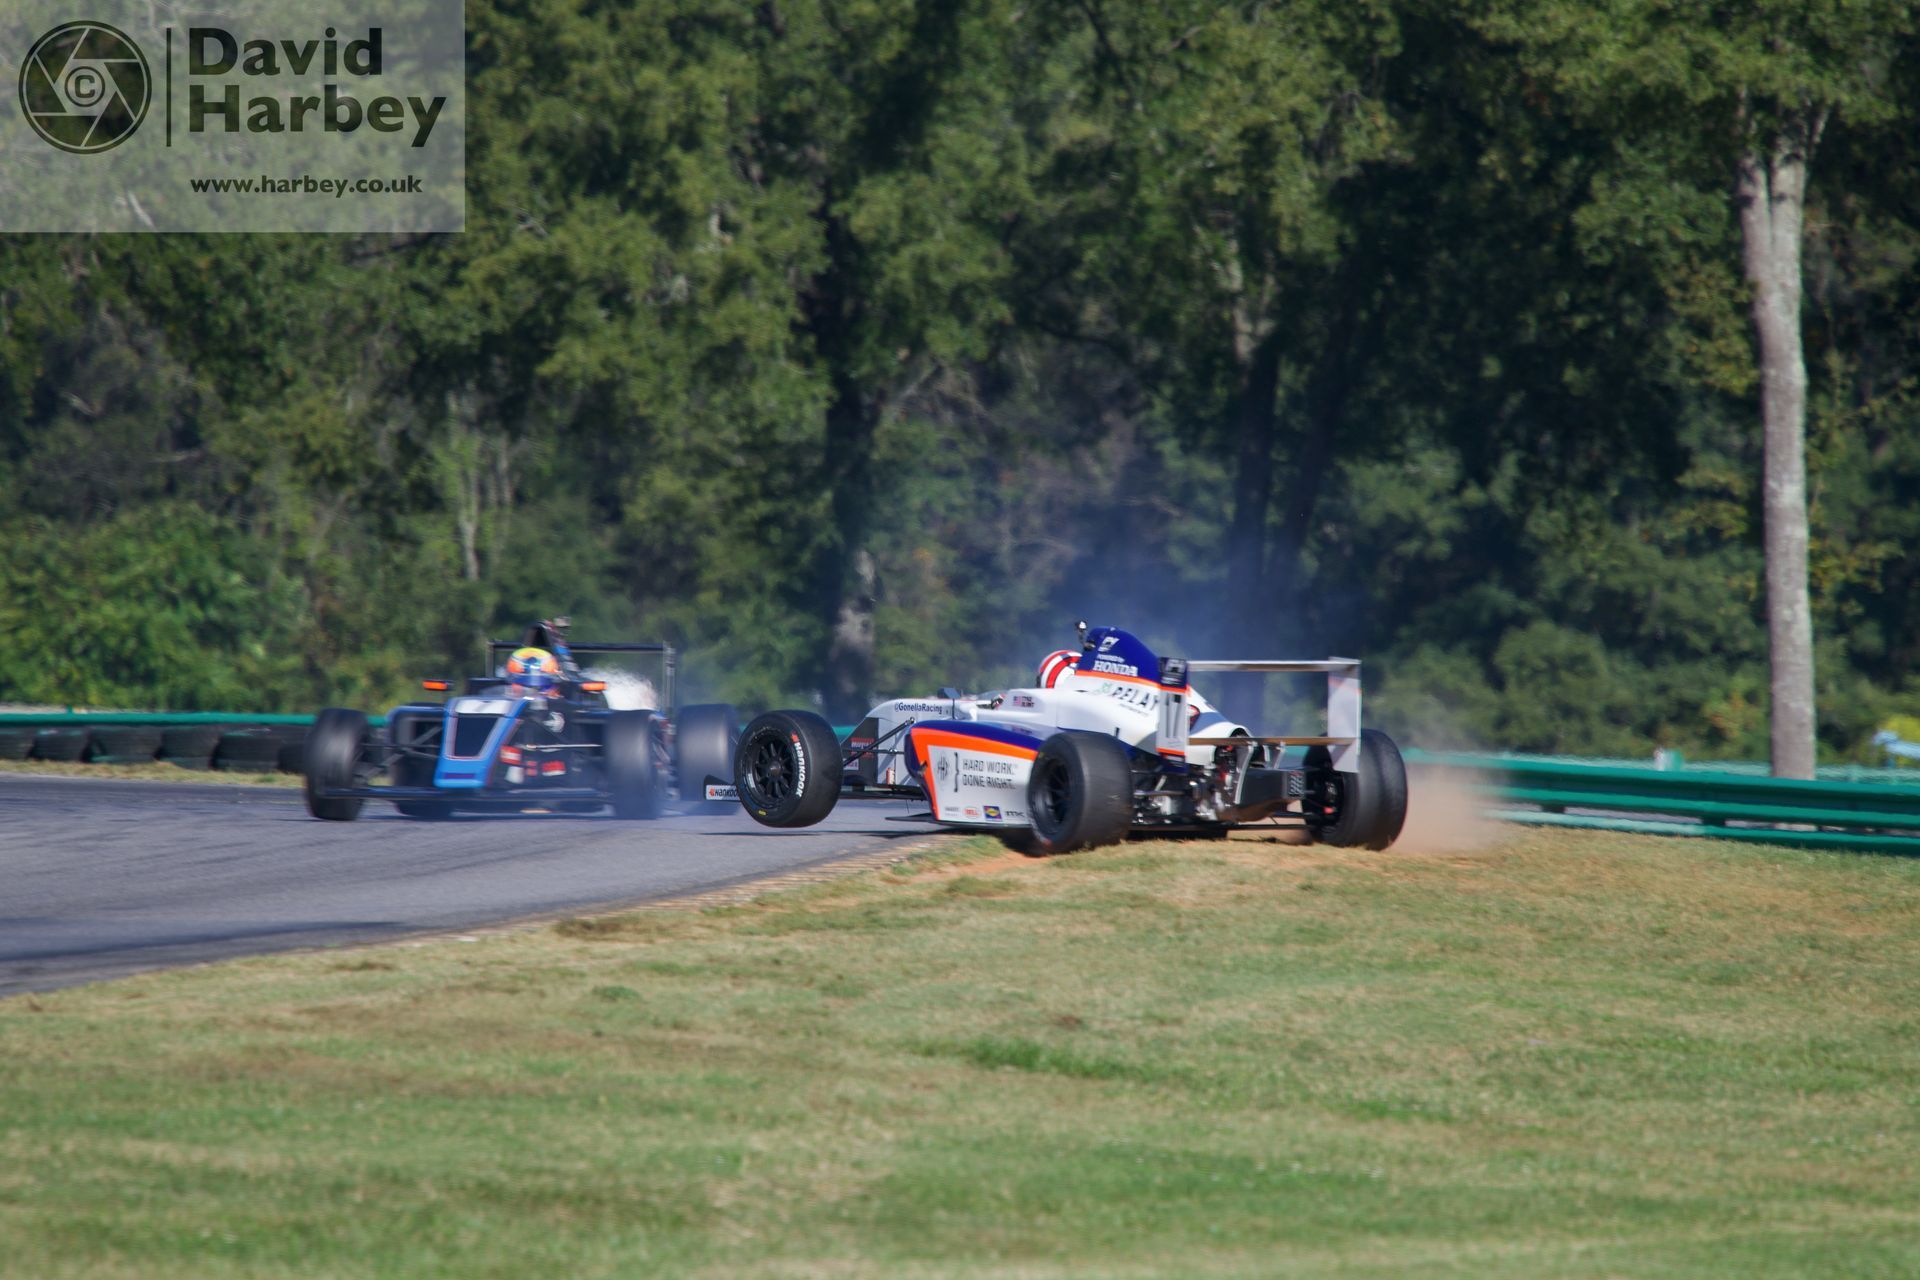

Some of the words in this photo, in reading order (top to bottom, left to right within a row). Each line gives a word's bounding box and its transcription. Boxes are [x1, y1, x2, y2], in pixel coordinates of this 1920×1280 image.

[1093, 660, 1138, 676] HONDA
[962, 759, 984, 772] HARD
[962, 774, 986, 788] DONE
